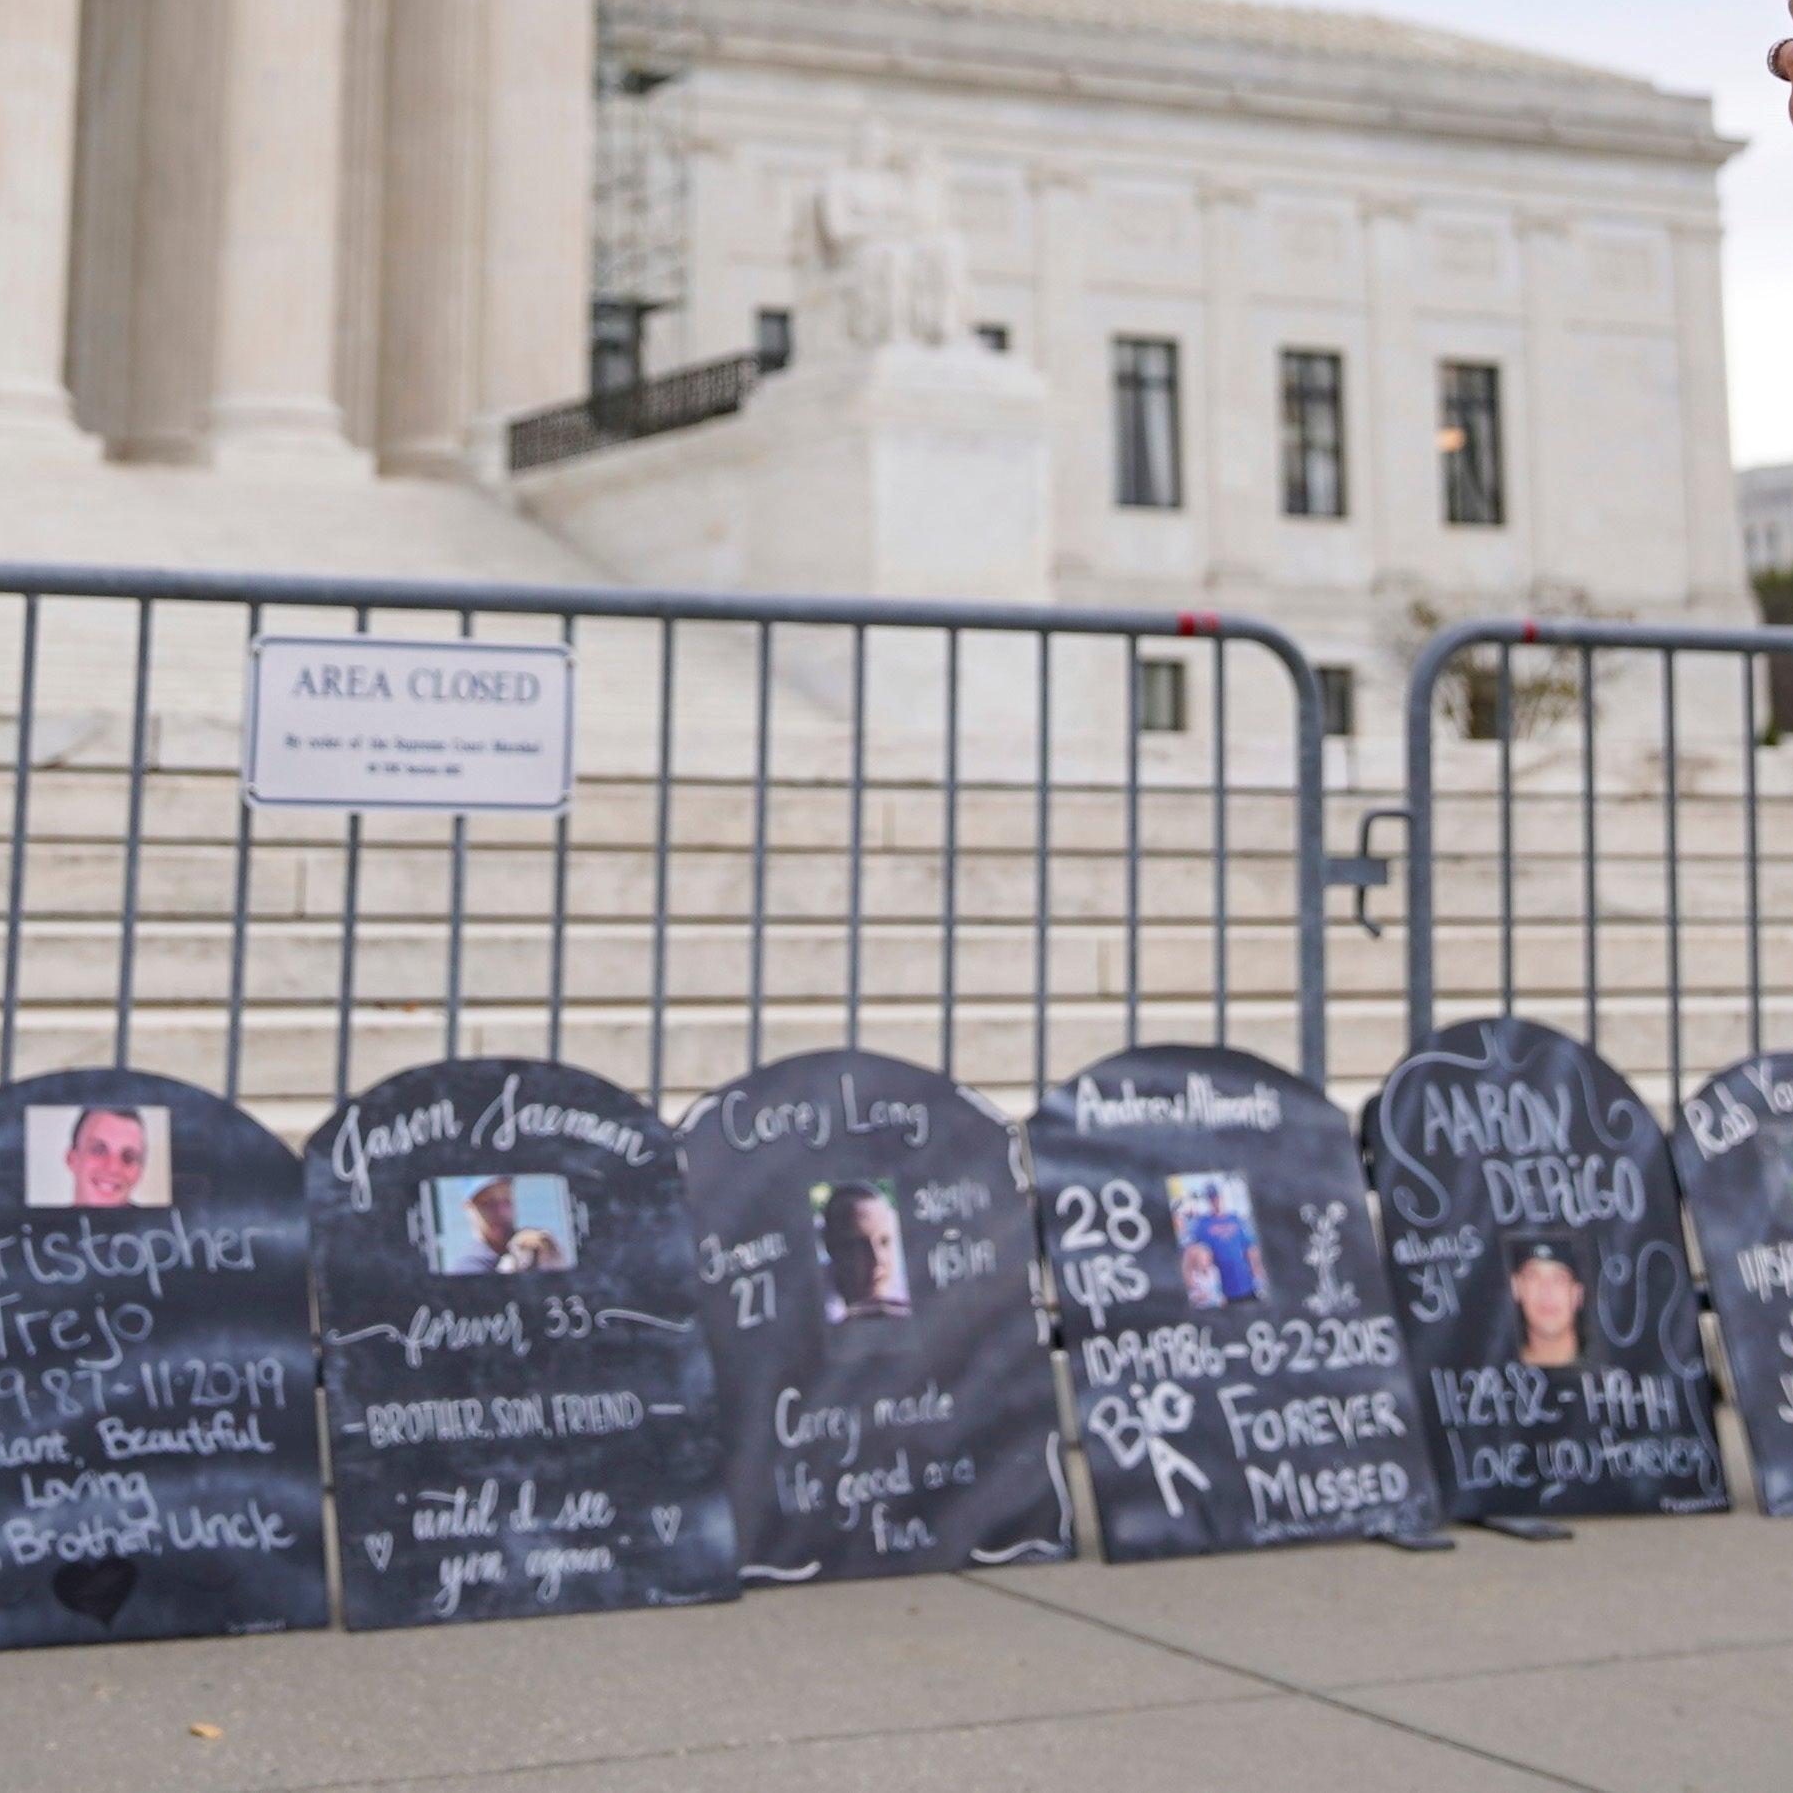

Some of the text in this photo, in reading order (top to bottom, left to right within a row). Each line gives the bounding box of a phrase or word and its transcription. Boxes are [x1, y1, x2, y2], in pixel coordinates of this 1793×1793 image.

[291, 665, 541, 702] AREA CLOSED
[722, 1090, 831, 1151] Corey
[1423, 1081, 1572, 1157] AARON
[1055, 1177, 1152, 1252] 28
[544, 1295, 593, 1339] 33
[730, 1270, 778, 1330] 27
[553, 1391, 644, 1439] FRIEND
